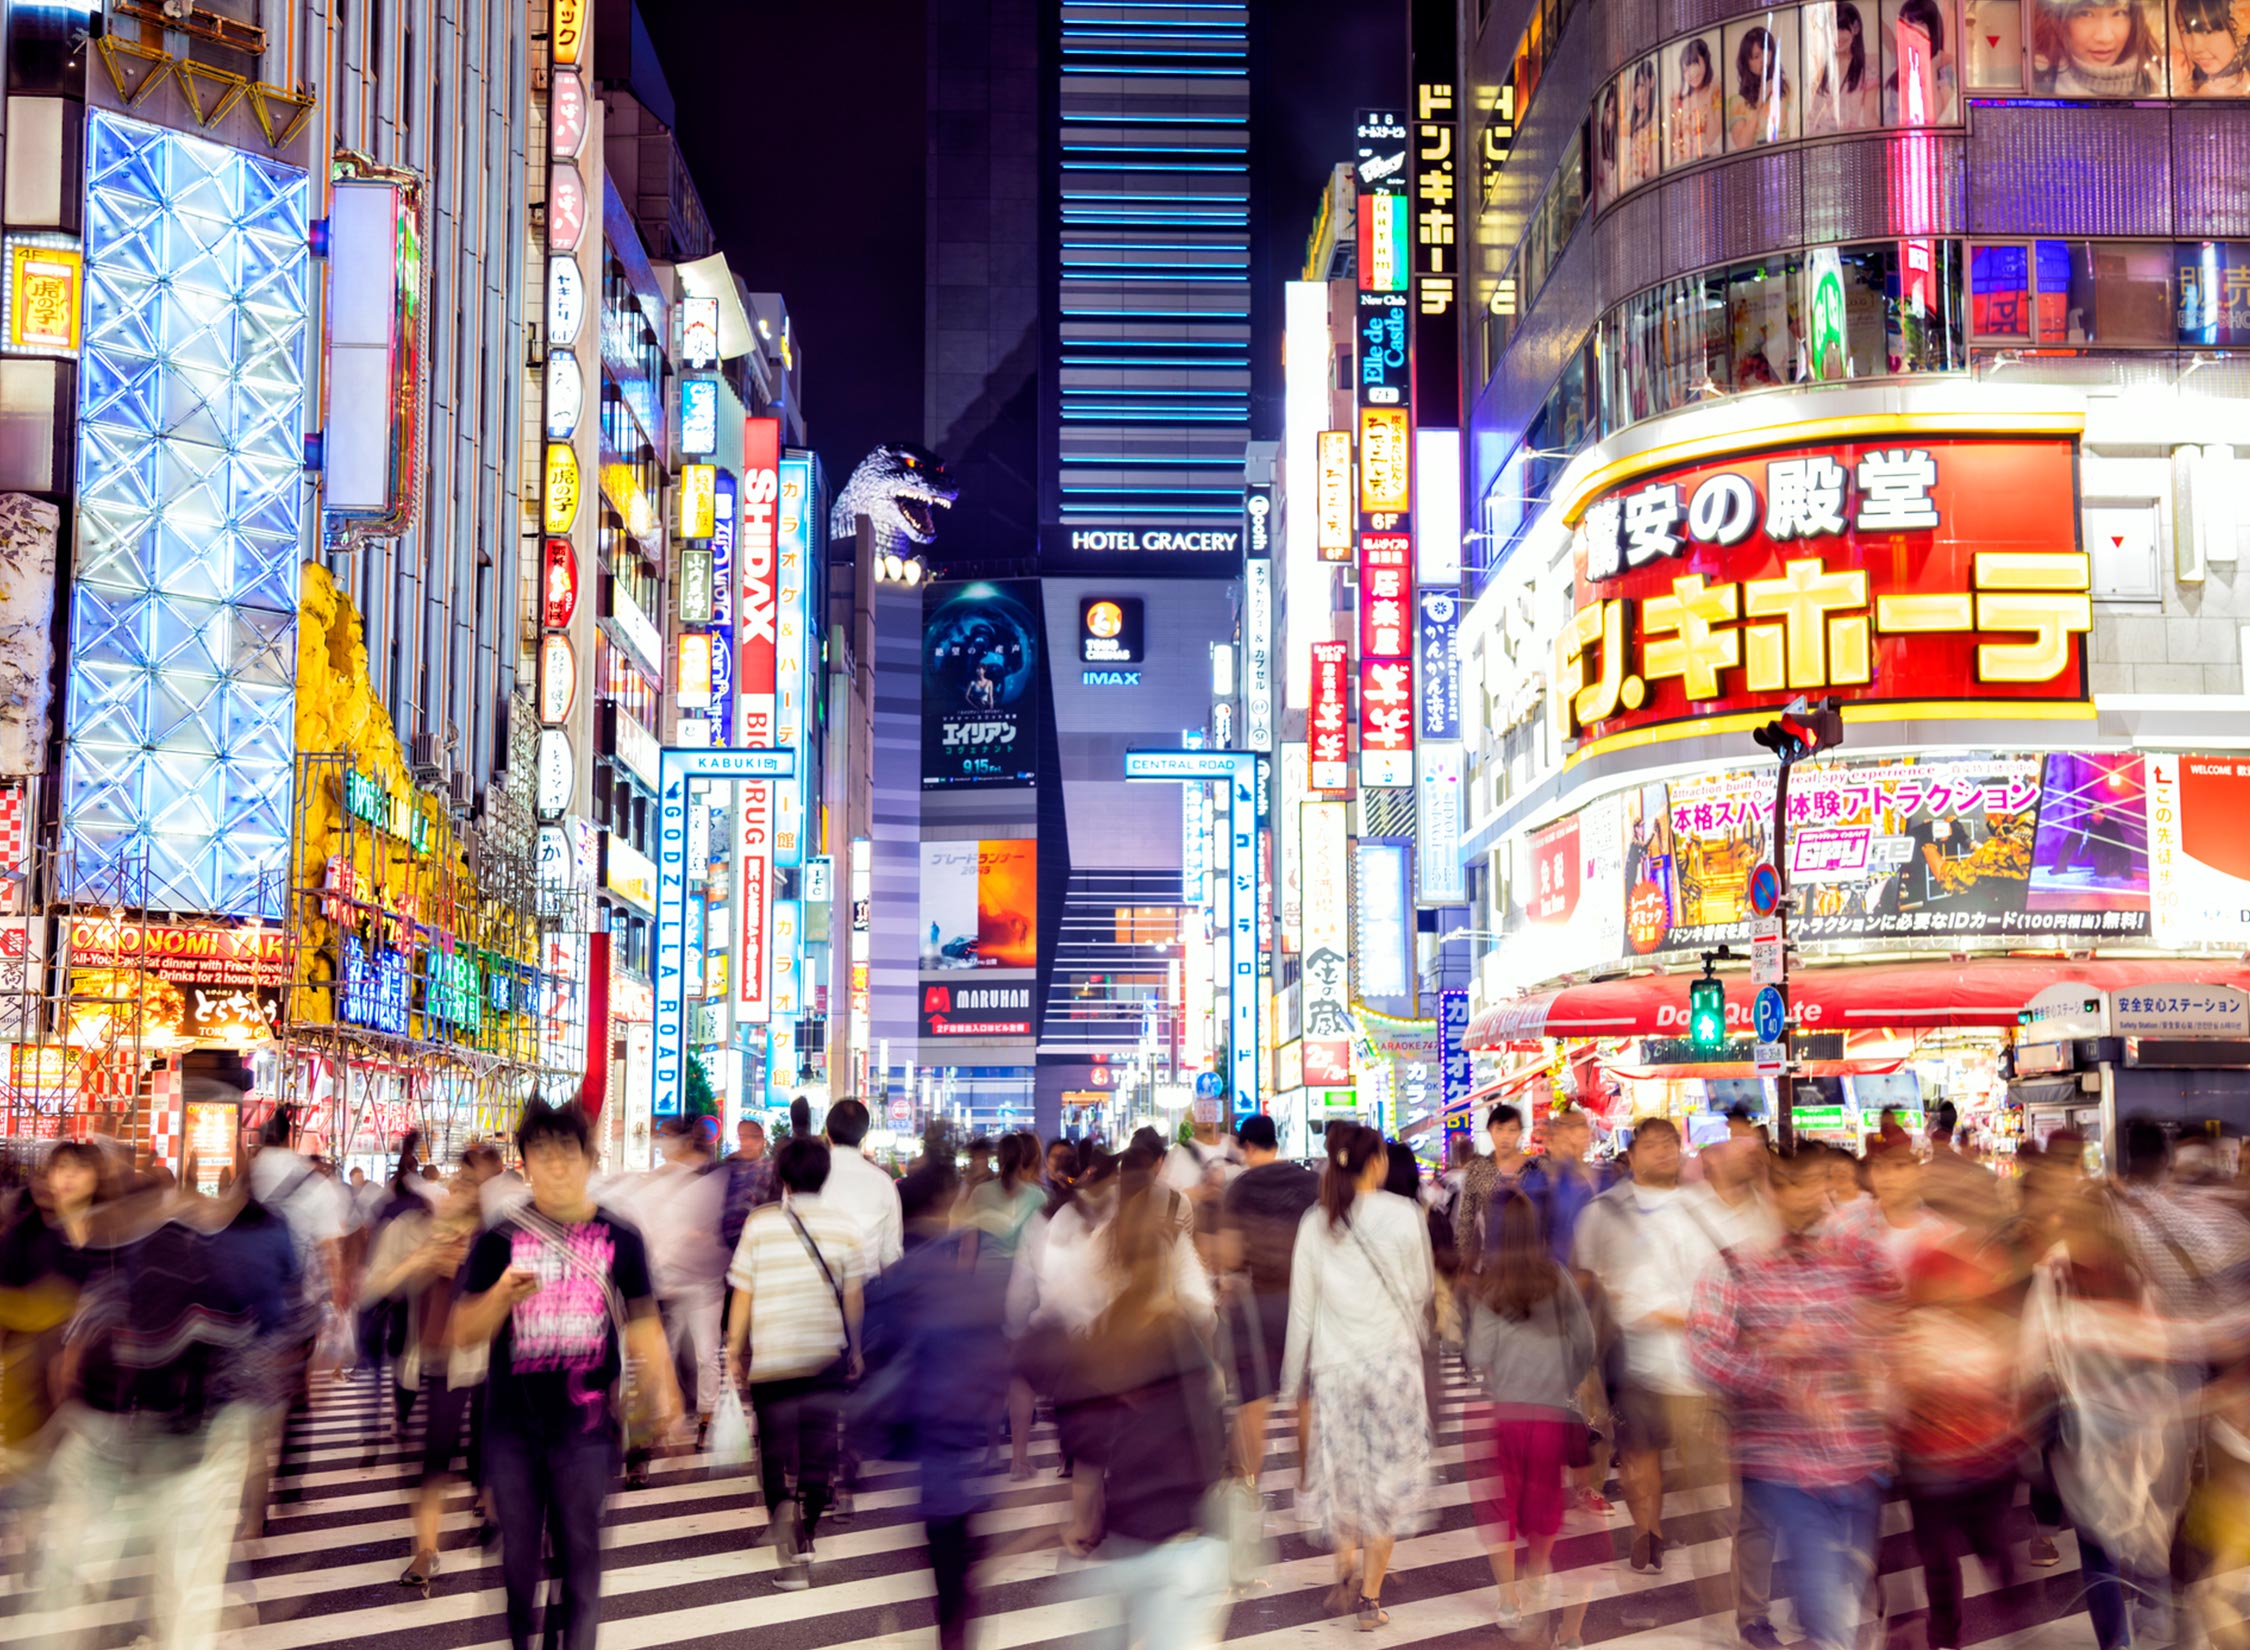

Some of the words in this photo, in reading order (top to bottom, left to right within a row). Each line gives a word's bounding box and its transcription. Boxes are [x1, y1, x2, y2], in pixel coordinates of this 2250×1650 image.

[18, 249, 44, 260] 4F
[32, 281, 60, 325] 虎の子
[1370, 317, 1384, 344] de
[1384, 307, 1405, 368] Castle
[1363, 347, 1384, 384] Elle
[551, 468, 575, 513] 虎の子
[1371, 513, 1399, 530] 6F
[1584, 448, 1940, 583] 驚安の殿堂
[745, 468, 777, 645] SHIDAX
[1072, 531, 1139, 550] HOTEL
[1142, 533, 1238, 551] GRACERY
[1083, 672, 1139, 685] IMAX
[942, 721, 1017, 745] エイリアン
[1132, 759, 1195, 769] CENTRAL
[1198, 759, 1236, 769] ROAD
[2190, 764, 2232, 776] WELCOME
[1672, 786, 1722, 799] Attraction
[1757, 778, 1774, 789] for
[1790, 772, 1817, 784] real
[1822, 772, 1846, 785] spy
[1852, 766, 1936, 781] experience
[659, 805, 682, 979] GODZILLA
[71, 925, 218, 957] OKONOMI
[1236, 832, 1252, 1062] ゴジラロード
[159, 969, 194, 985] Drinks
[196, 972, 212, 985] for
[213, 973, 222, 984] 2
[161, 956, 198, 971] dinner
[200, 958, 223, 972] with
[771, 918, 793, 1087] カラオケ館
[956, 989, 1030, 1008] MARUHAN
[1306, 946, 1346, 1036] 金の蔵
[2118, 997, 2241, 1013] 安全安心ステーション
[1759, 1000, 1772, 1034] P
[1768, 1018, 1779, 1034] 40
[658, 1000, 678, 1083] ROAD
